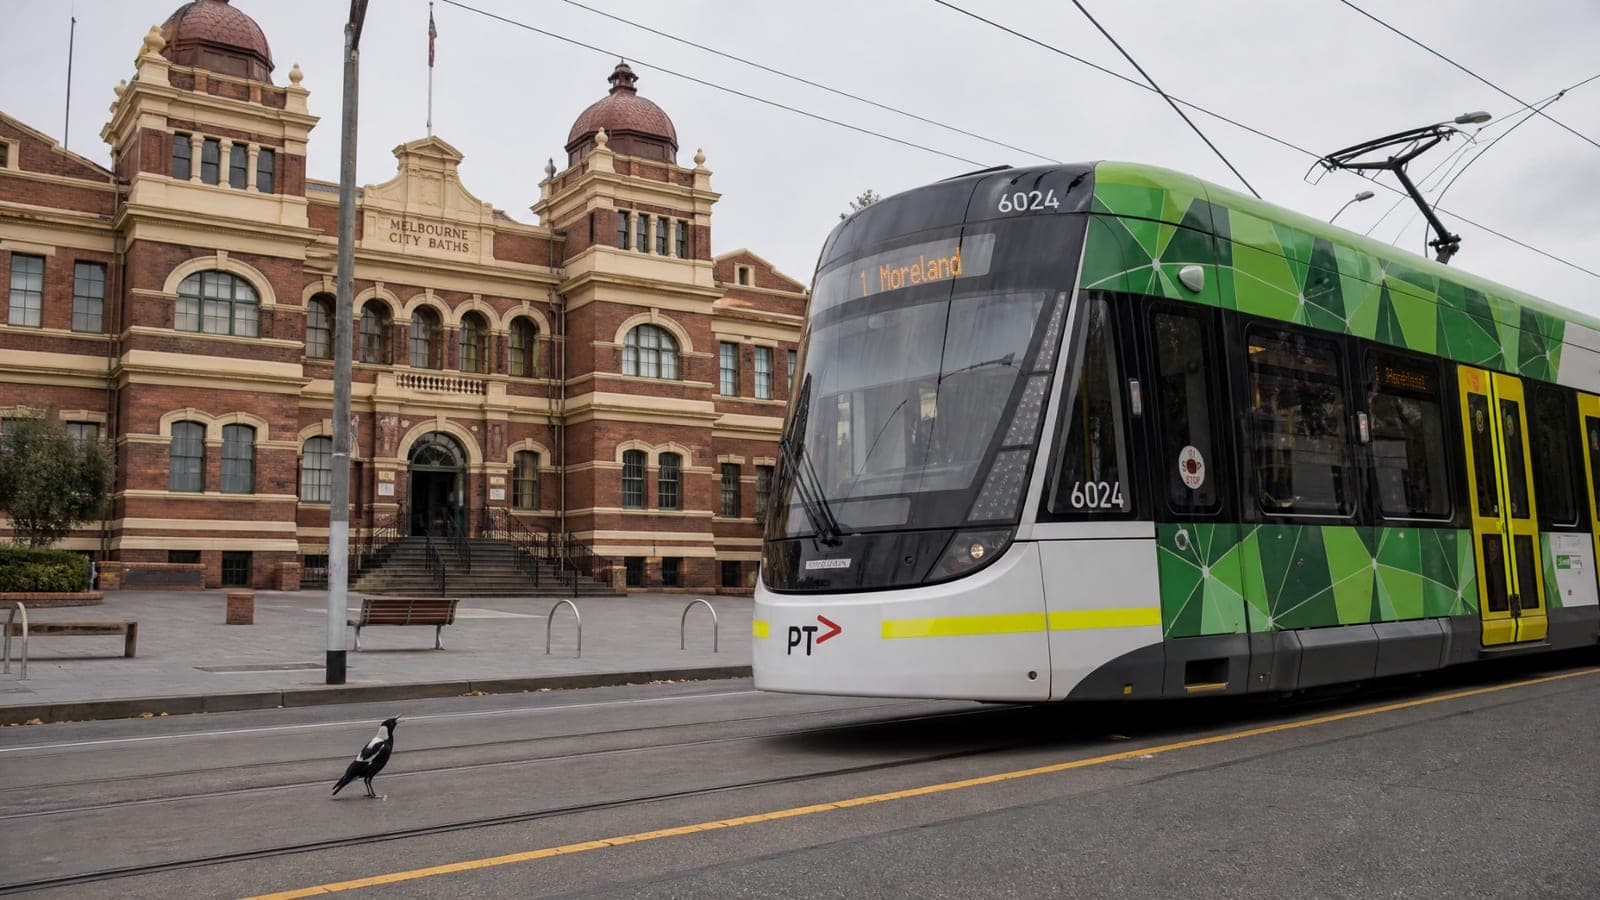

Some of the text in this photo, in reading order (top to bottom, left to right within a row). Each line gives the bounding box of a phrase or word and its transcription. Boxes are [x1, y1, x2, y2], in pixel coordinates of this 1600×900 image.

[998, 189, 1060, 213] 6024
[390, 218, 469, 240] MELBOURNE
[389, 232, 469, 253] CITY BATHS
[860, 245, 962, 298] 1 Moreland
[1071, 481, 1124, 508] 6024
